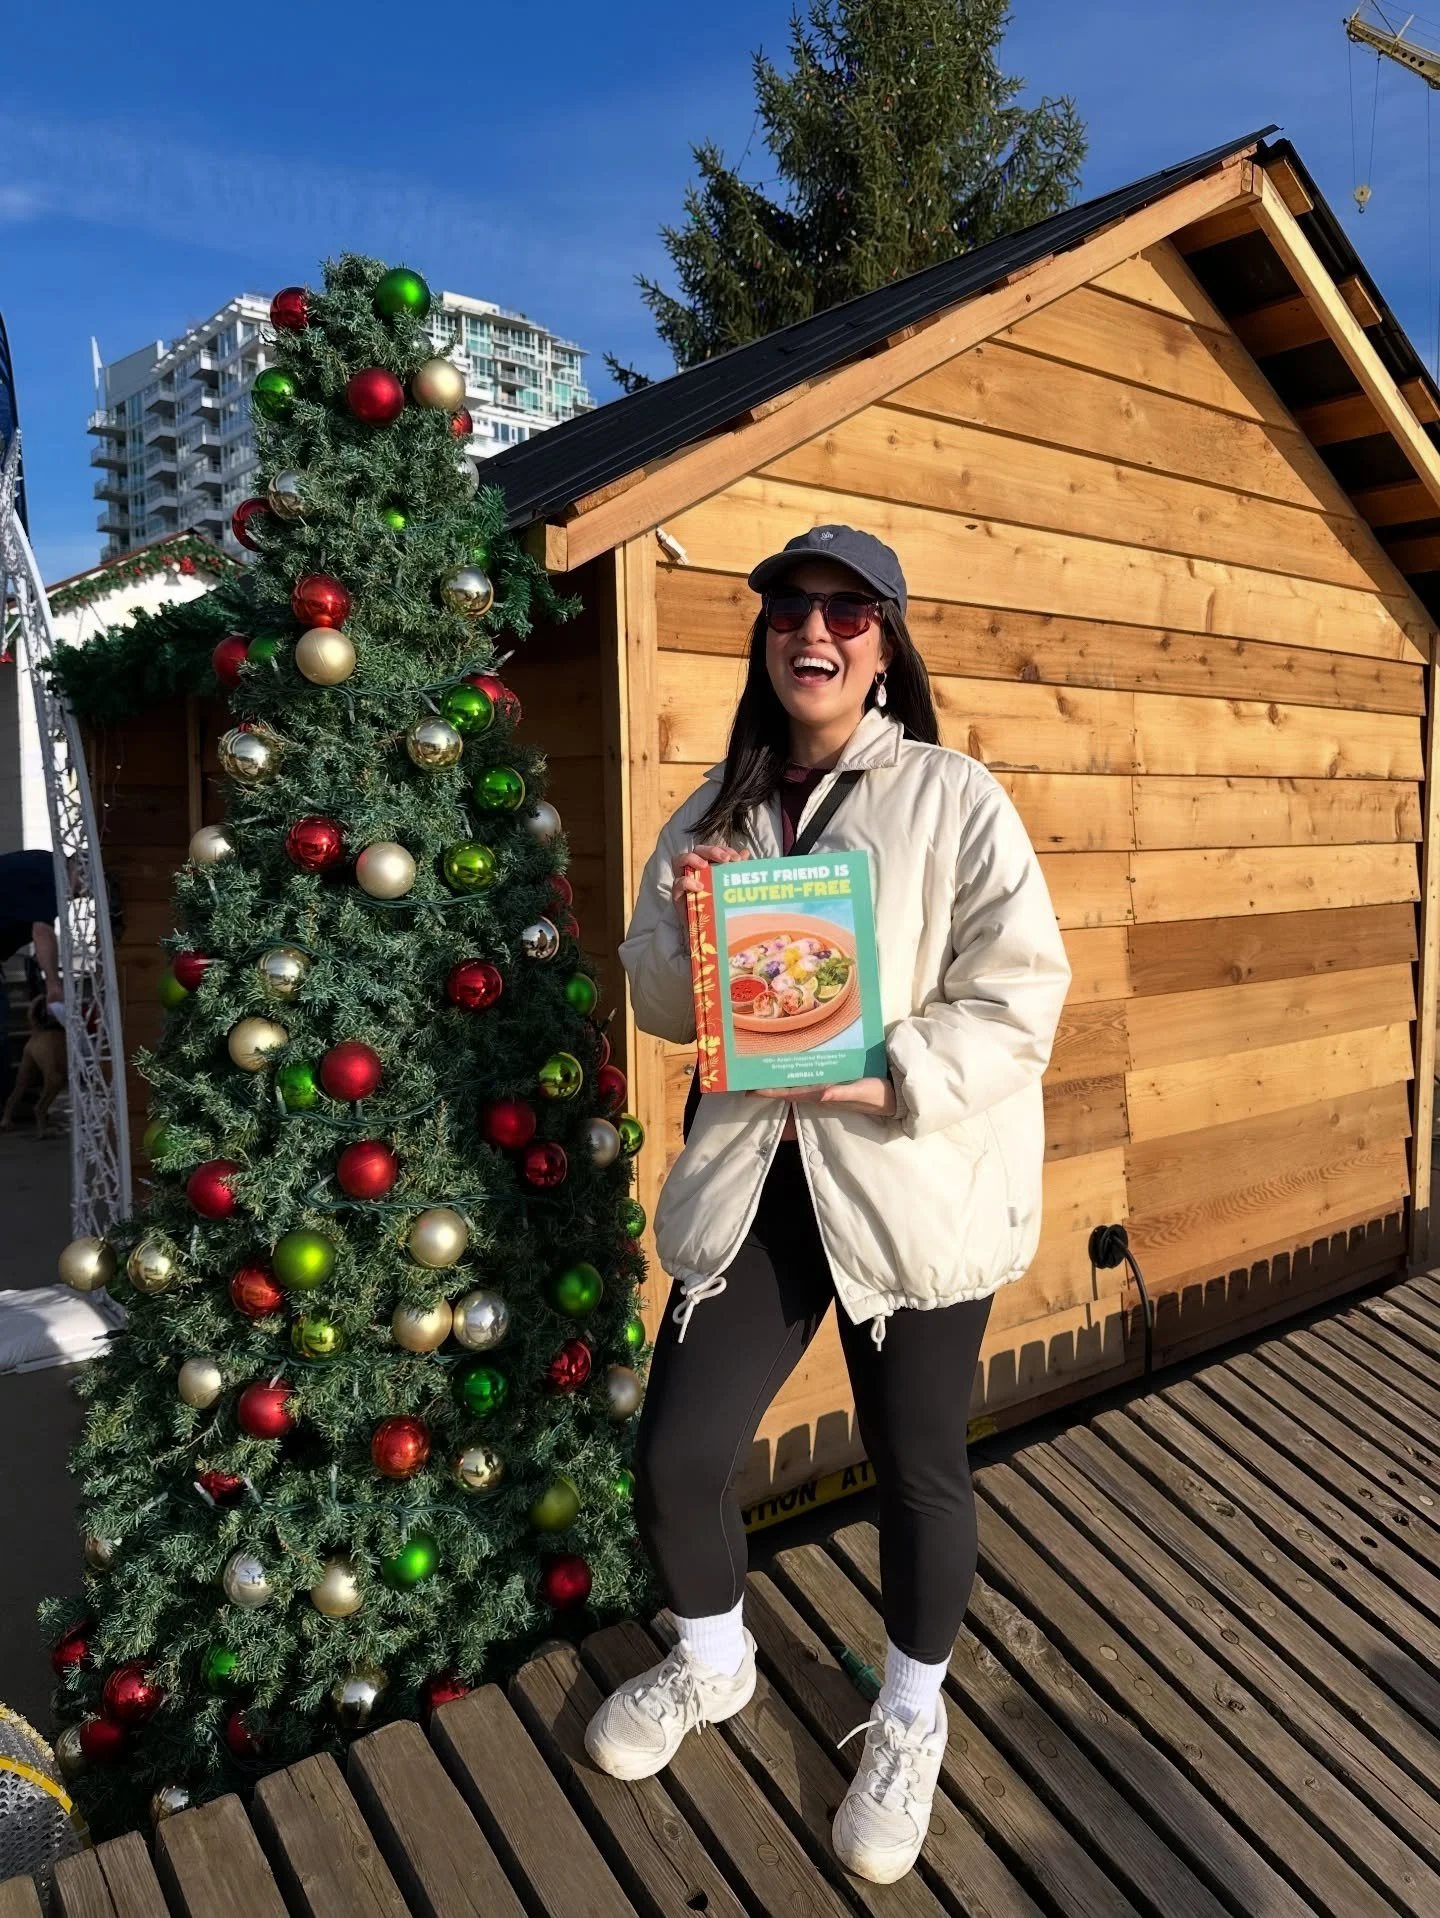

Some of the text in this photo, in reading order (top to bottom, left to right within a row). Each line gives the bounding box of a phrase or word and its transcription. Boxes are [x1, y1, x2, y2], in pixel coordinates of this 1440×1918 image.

[731, 871, 769, 885] BEST
[773, 866, 829, 881] FRIEND
[834, 864, 849, 876] IS
[723, 879, 851, 903] GLUTEN-FREE
